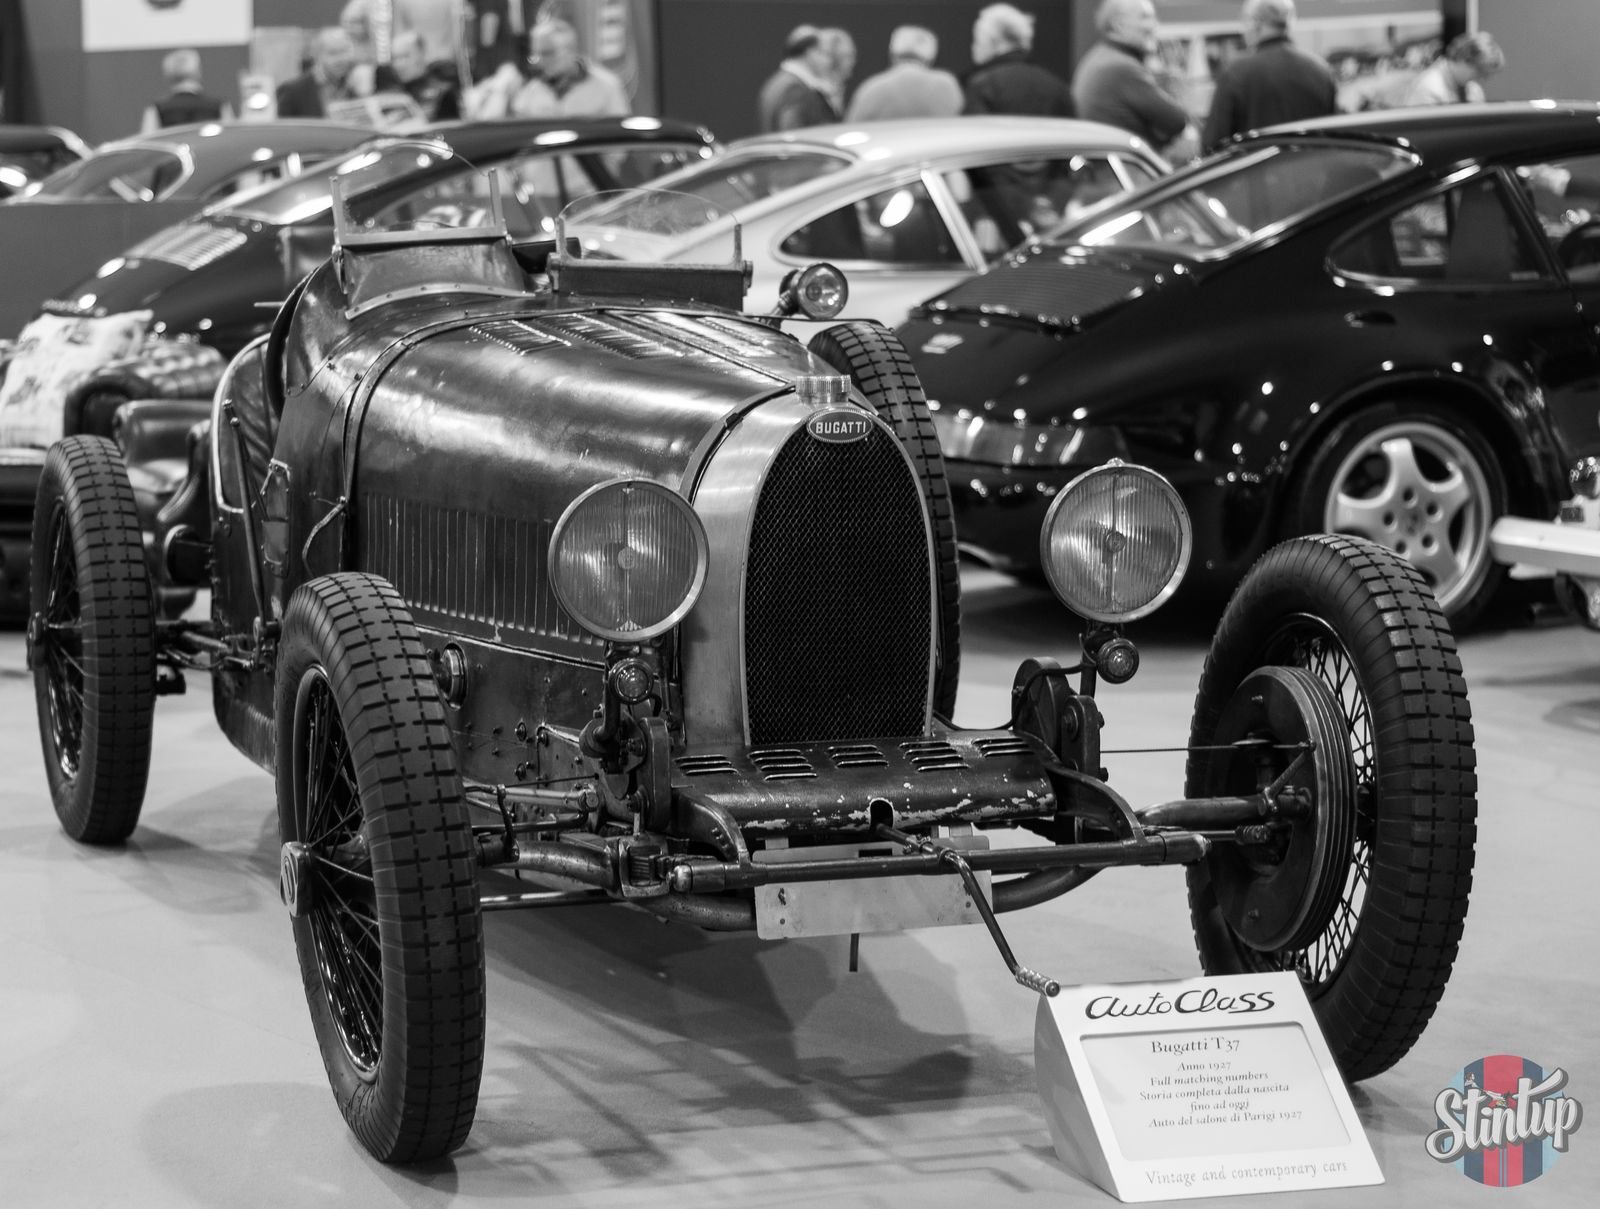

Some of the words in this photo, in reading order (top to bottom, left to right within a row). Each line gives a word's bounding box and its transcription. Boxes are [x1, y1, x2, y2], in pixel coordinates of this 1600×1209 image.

[815, 421, 866, 434] BUGATTI
[1151, 1038, 1208, 1056] Bugatti
[1211, 1036, 1240, 1052] T37
[1177, 1062, 1205, 1072] Anno
[1208, 1062, 1231, 1070] 1927
[1150, 1076, 1171, 1086] Full
[1174, 1074, 1224, 1085] matching
[1225, 1071, 1269, 1081] numbers
[1139, 1090, 1172, 1100] Storia
[1175, 1087, 1221, 1099] completa
[1224, 1085, 1250, 1095] dalla
[1253, 1083, 1289, 1093] nascita
[1190, 1101, 1210, 1113] fino
[1213, 1100, 1226, 1109] ad
[1148, 1118, 1175, 1127] Auto
[1177, 1115, 1193, 1125] del
[1195, 1114, 1227, 1124] salone
[1230, 1112, 1241, 1122] di
[1244, 1111, 1276, 1122] Parigi
[1279, 1111, 1302, 1120] 1927
[1146, 1169, 1197, 1188] Vintage
[1202, 1165, 1227, 1182] and
[1231, 1163, 1317, 1181] contemporary
[1322, 1160, 1348, 1173] cars
